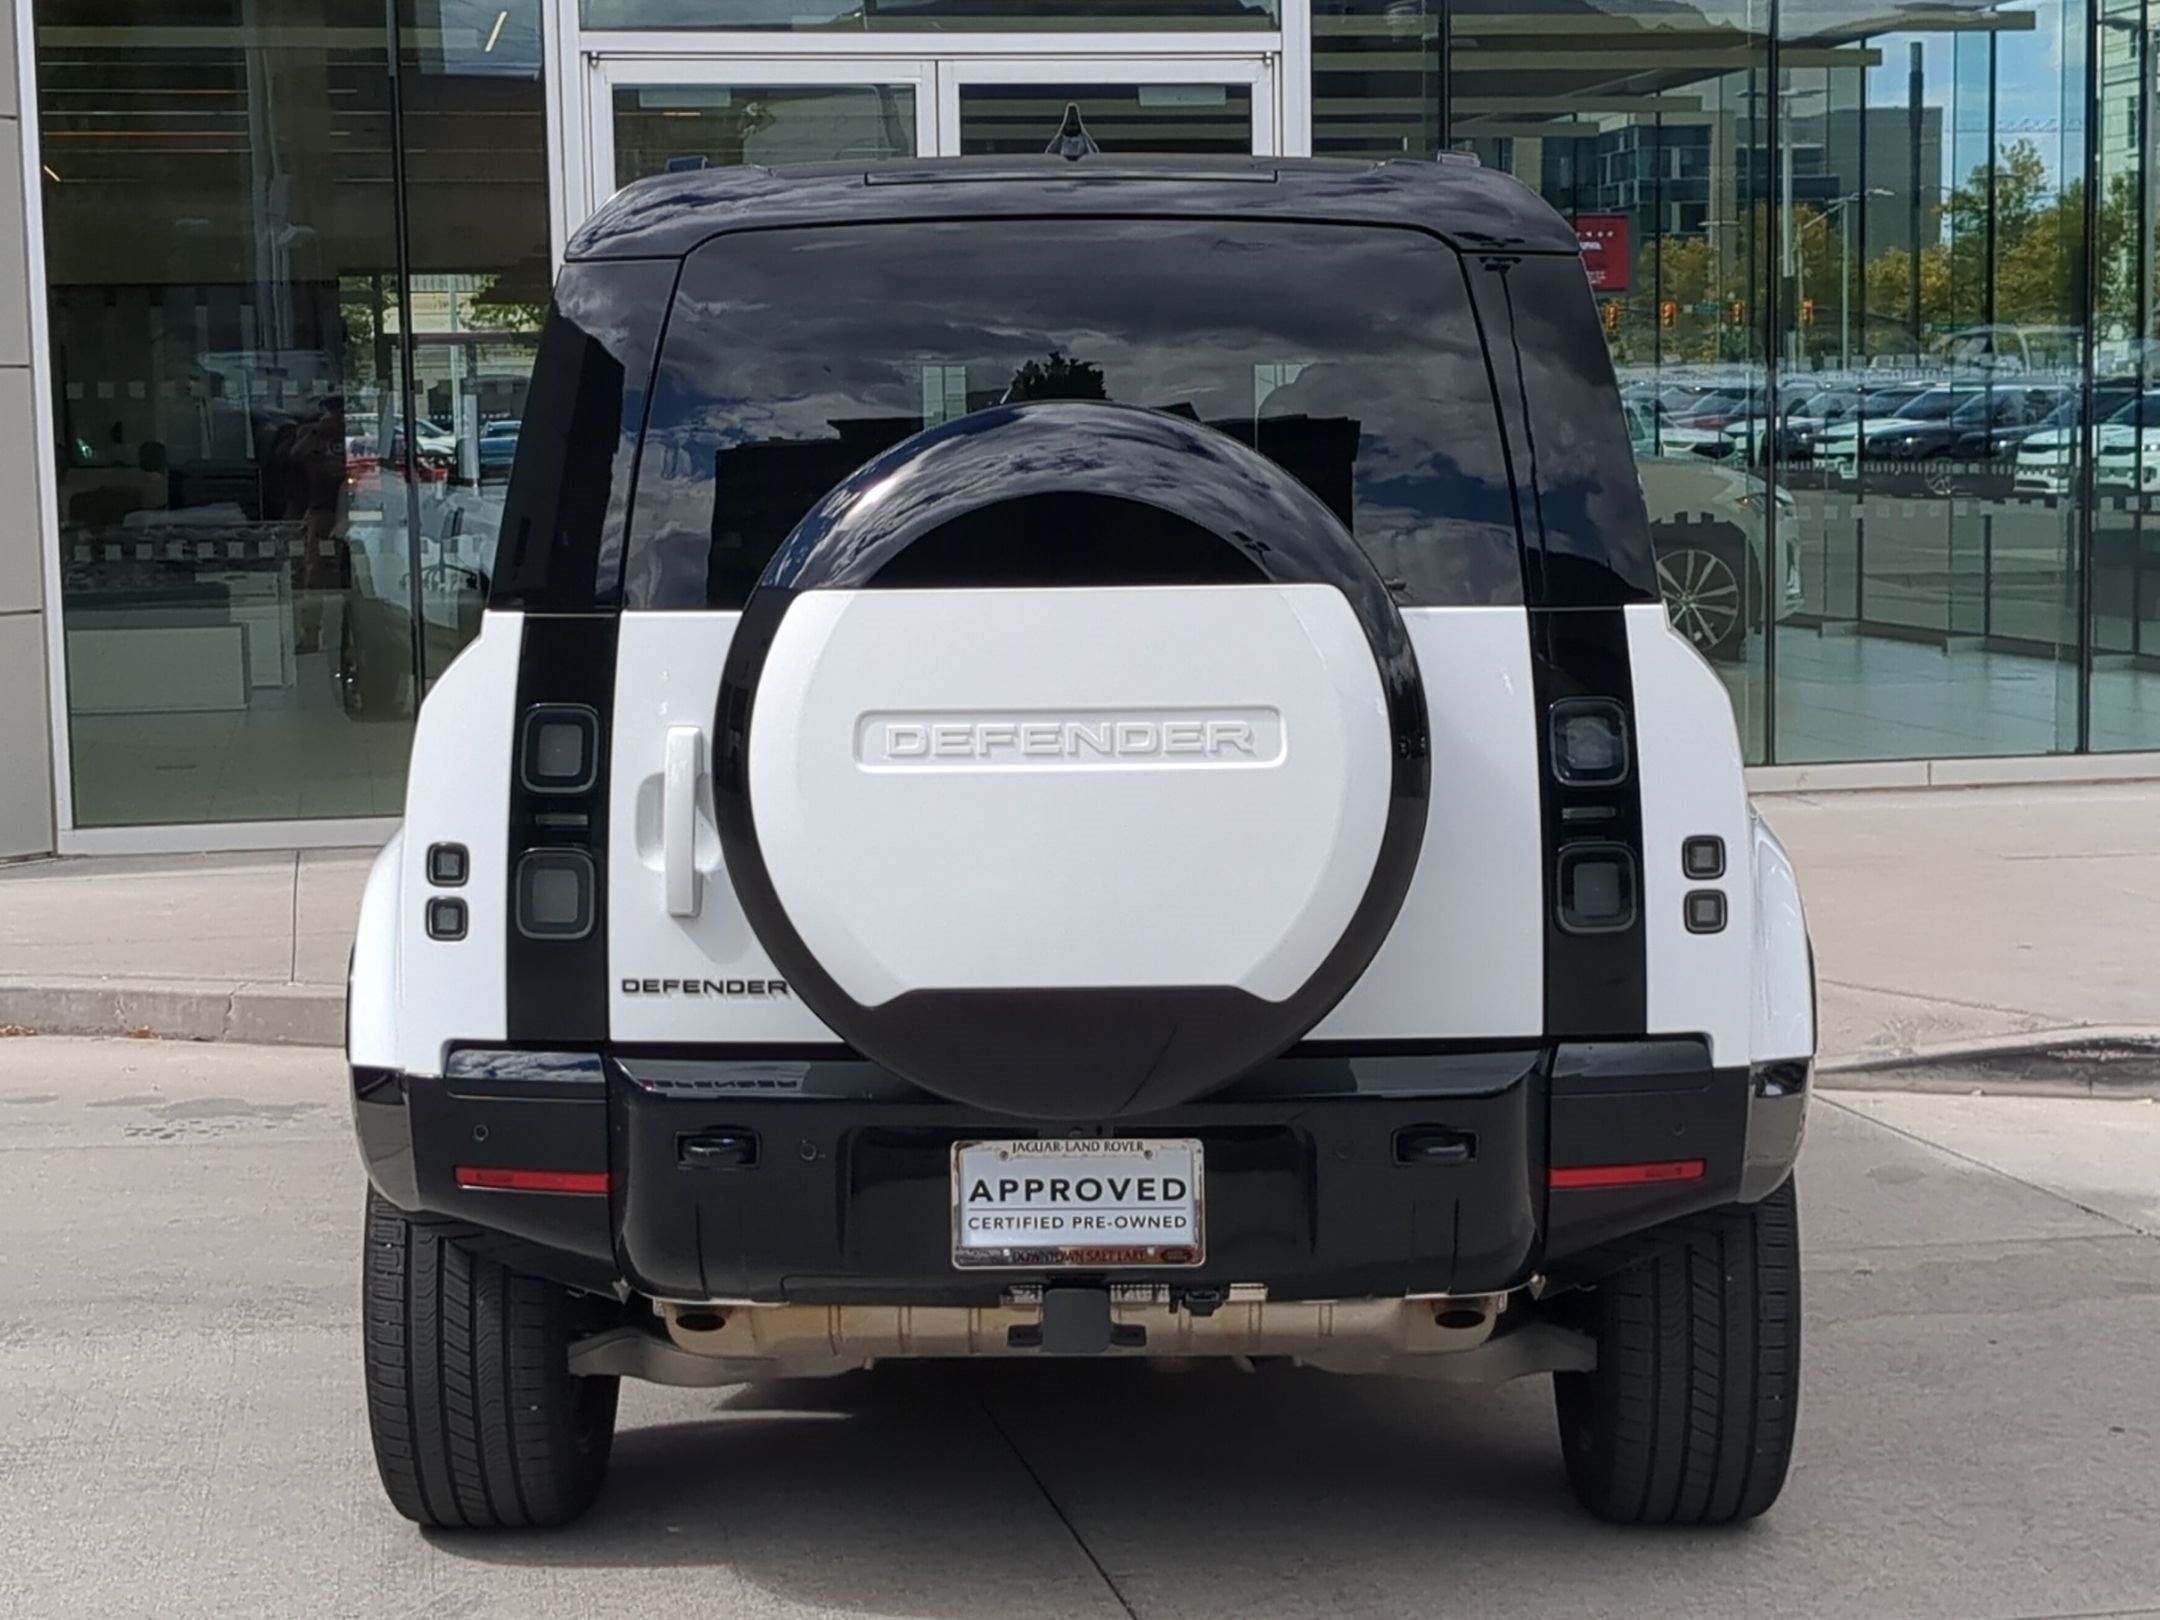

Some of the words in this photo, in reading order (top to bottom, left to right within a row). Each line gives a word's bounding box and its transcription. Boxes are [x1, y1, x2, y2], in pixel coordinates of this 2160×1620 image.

[886, 721, 1257, 758] DEFENDER
[621, 979, 789, 995] DEFENDER
[1104, 1140, 1144, 1152] ROVER
[968, 1178, 1186, 1202] APPROVED
[968, 1216, 1064, 1229] CERTIFIED
[1072, 1215, 1187, 1229] PRE-OWNED
